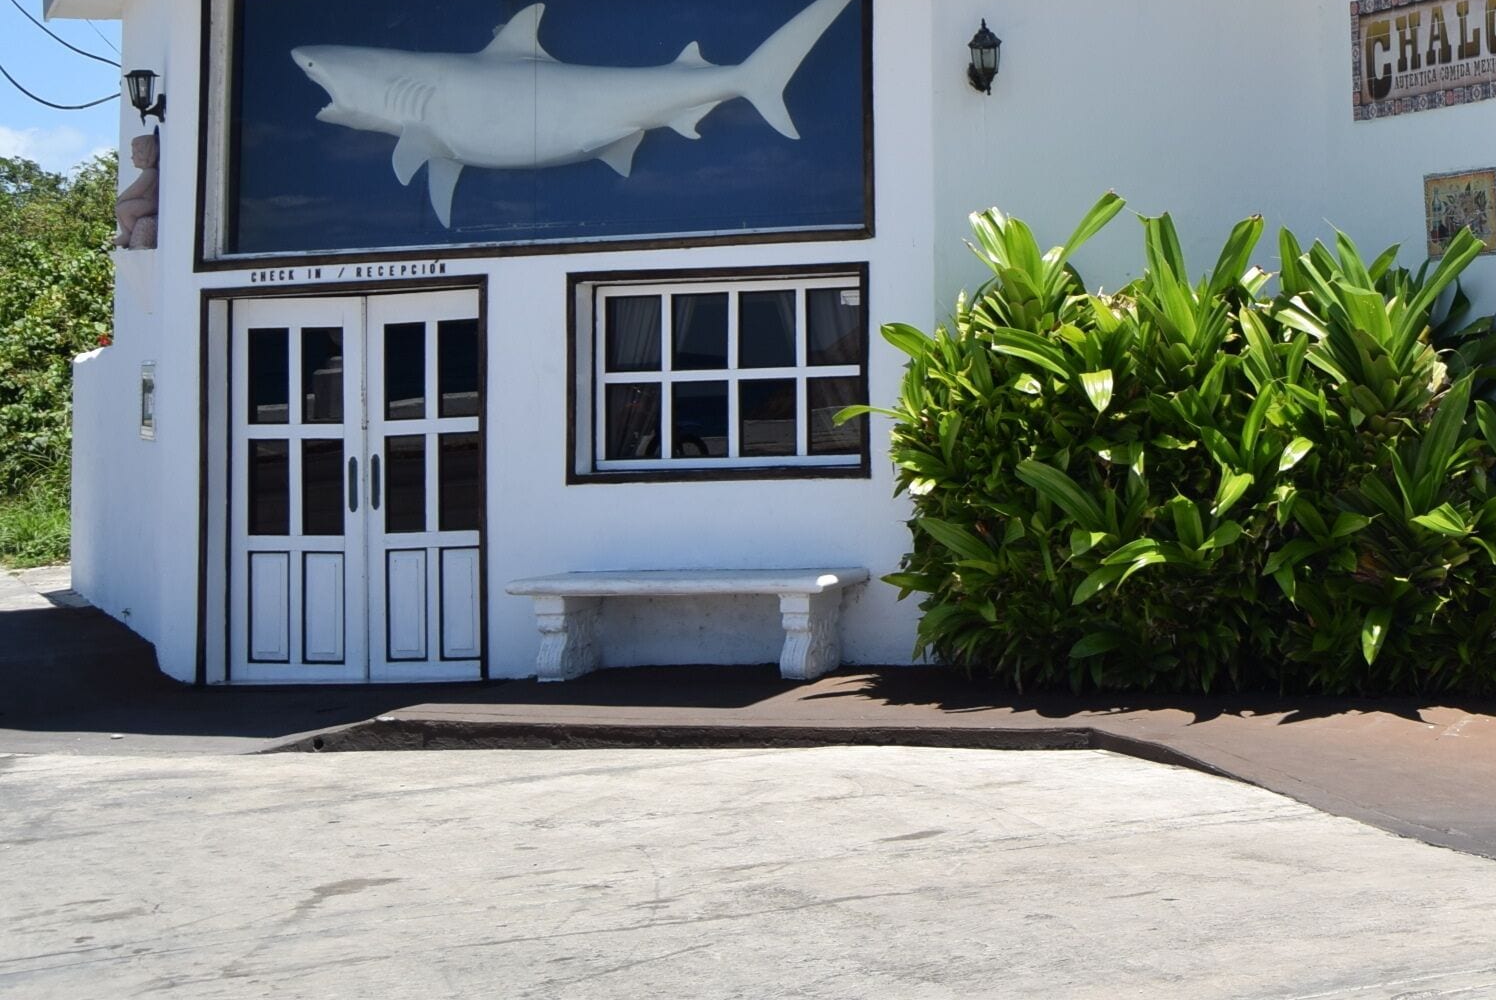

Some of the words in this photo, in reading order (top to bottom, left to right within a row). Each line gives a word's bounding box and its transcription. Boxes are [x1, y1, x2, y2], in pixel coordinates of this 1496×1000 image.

[1394, 69, 1437, 90] AUTENTICA
[1440, 62, 1471, 81] COMIDA
[251, 269, 294, 283] CHECK
[308, 268, 321, 280] IN
[356, 259, 446, 279] RECEPCIÓN
